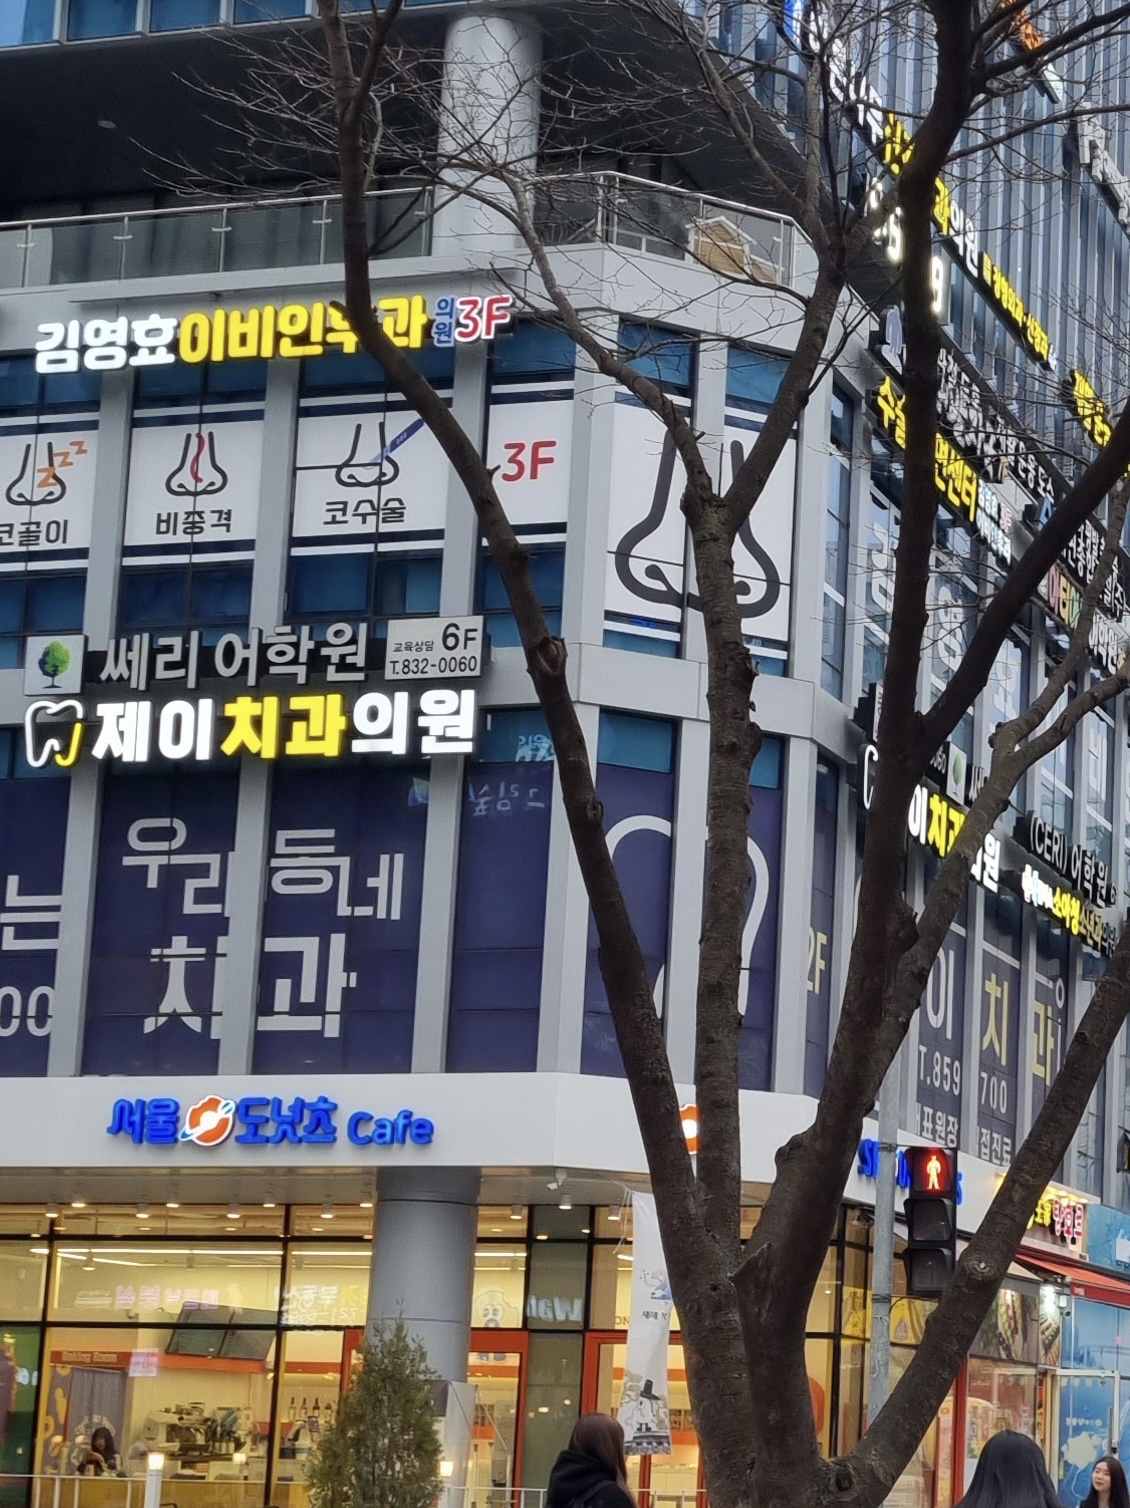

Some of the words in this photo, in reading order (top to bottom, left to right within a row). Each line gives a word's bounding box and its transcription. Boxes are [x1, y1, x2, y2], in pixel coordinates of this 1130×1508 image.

[454, 296, 512, 343] 3F
[501, 441, 557, 482] 3F
[0, 518, 69, 545] 코골이
[155, 508, 233, 537] 비중격
[323, 497, 407, 526] 코수술
[99, 630, 199, 691] 쎄리
[214, 622, 368, 686] 어학원
[393, 639, 434, 653] 교육상담
[441, 622, 478, 652] 6F
[389, 656, 478, 675] T.832-0060
[91, 689, 476, 763] 제이치과의원
[908, 782, 1001, 894] 이치과원
[123, 817, 235, 918] 우리
[919, 1045, 961, 1096] T.859
[107, 1098, 181, 1145] 서울
[234, 1096, 338, 1145] 도넛츠
[347, 1108, 434, 1146] Cafe
[976, 1125, 1012, 1167] 접진료
